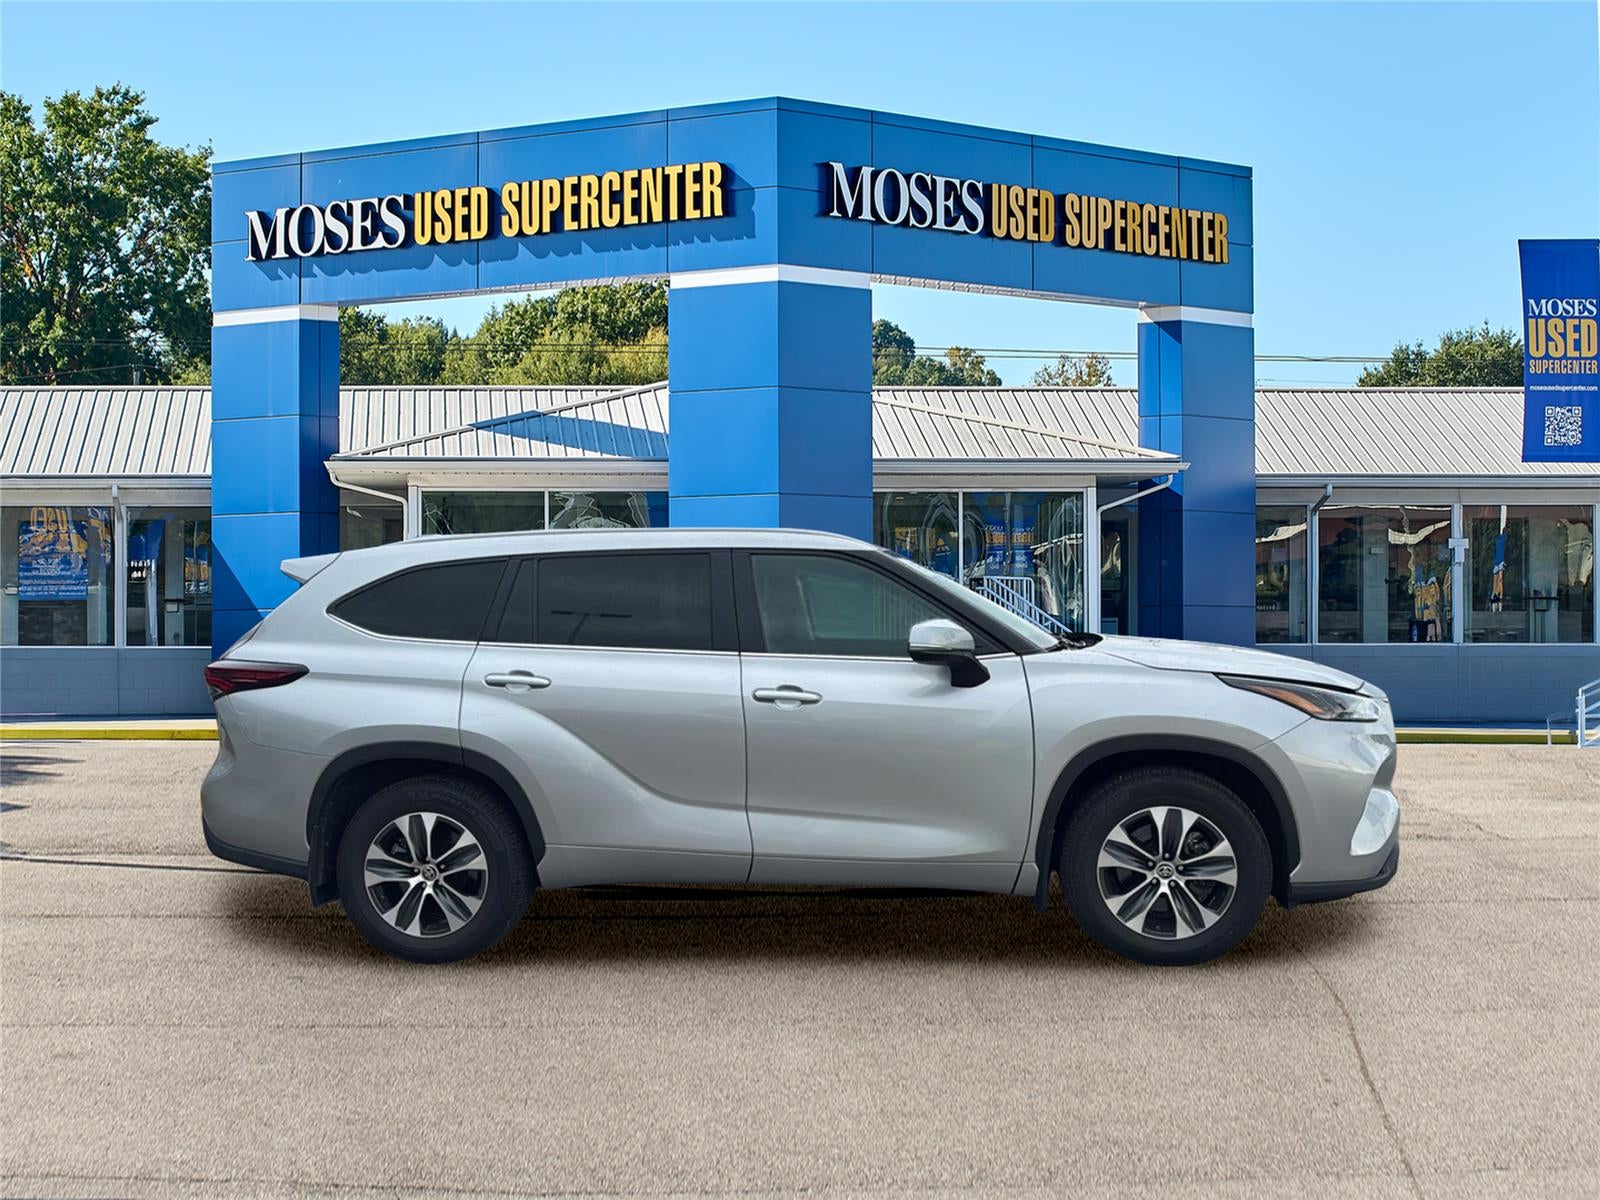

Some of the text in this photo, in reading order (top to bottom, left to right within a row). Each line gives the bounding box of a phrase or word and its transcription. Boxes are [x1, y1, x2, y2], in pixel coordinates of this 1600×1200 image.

[245, 161, 724, 262] MOSES USED SUPERCENTER
[829, 161, 1230, 264] MOSES USED SUPERCENTER
[1527, 298, 1597, 317] MOSES
[1528, 318, 1598, 358] USED
[1529, 359, 1598, 374] SUPERCENTER
